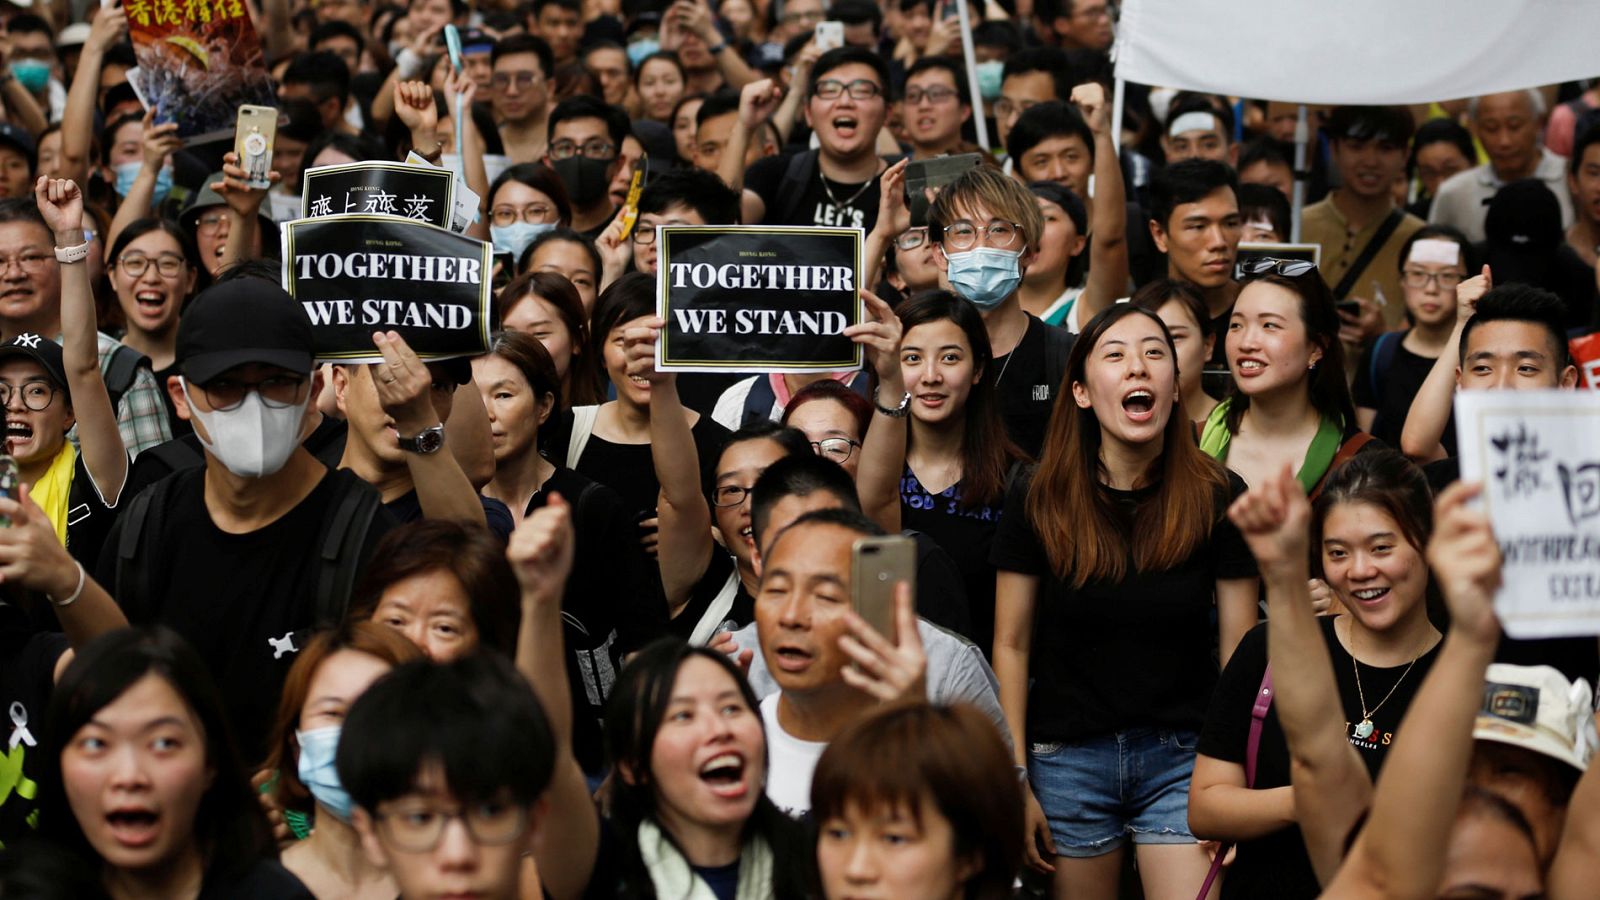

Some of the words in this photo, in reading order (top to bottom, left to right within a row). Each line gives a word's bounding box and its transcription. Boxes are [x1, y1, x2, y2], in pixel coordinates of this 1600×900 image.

[295, 252, 481, 284] TOGETHER
[669, 263, 855, 291] TOGETHER
[302, 300, 356, 326] WE
[362, 299, 473, 330] STAND
[673, 309, 727, 334] WE
[735, 309, 847, 335] STAND
